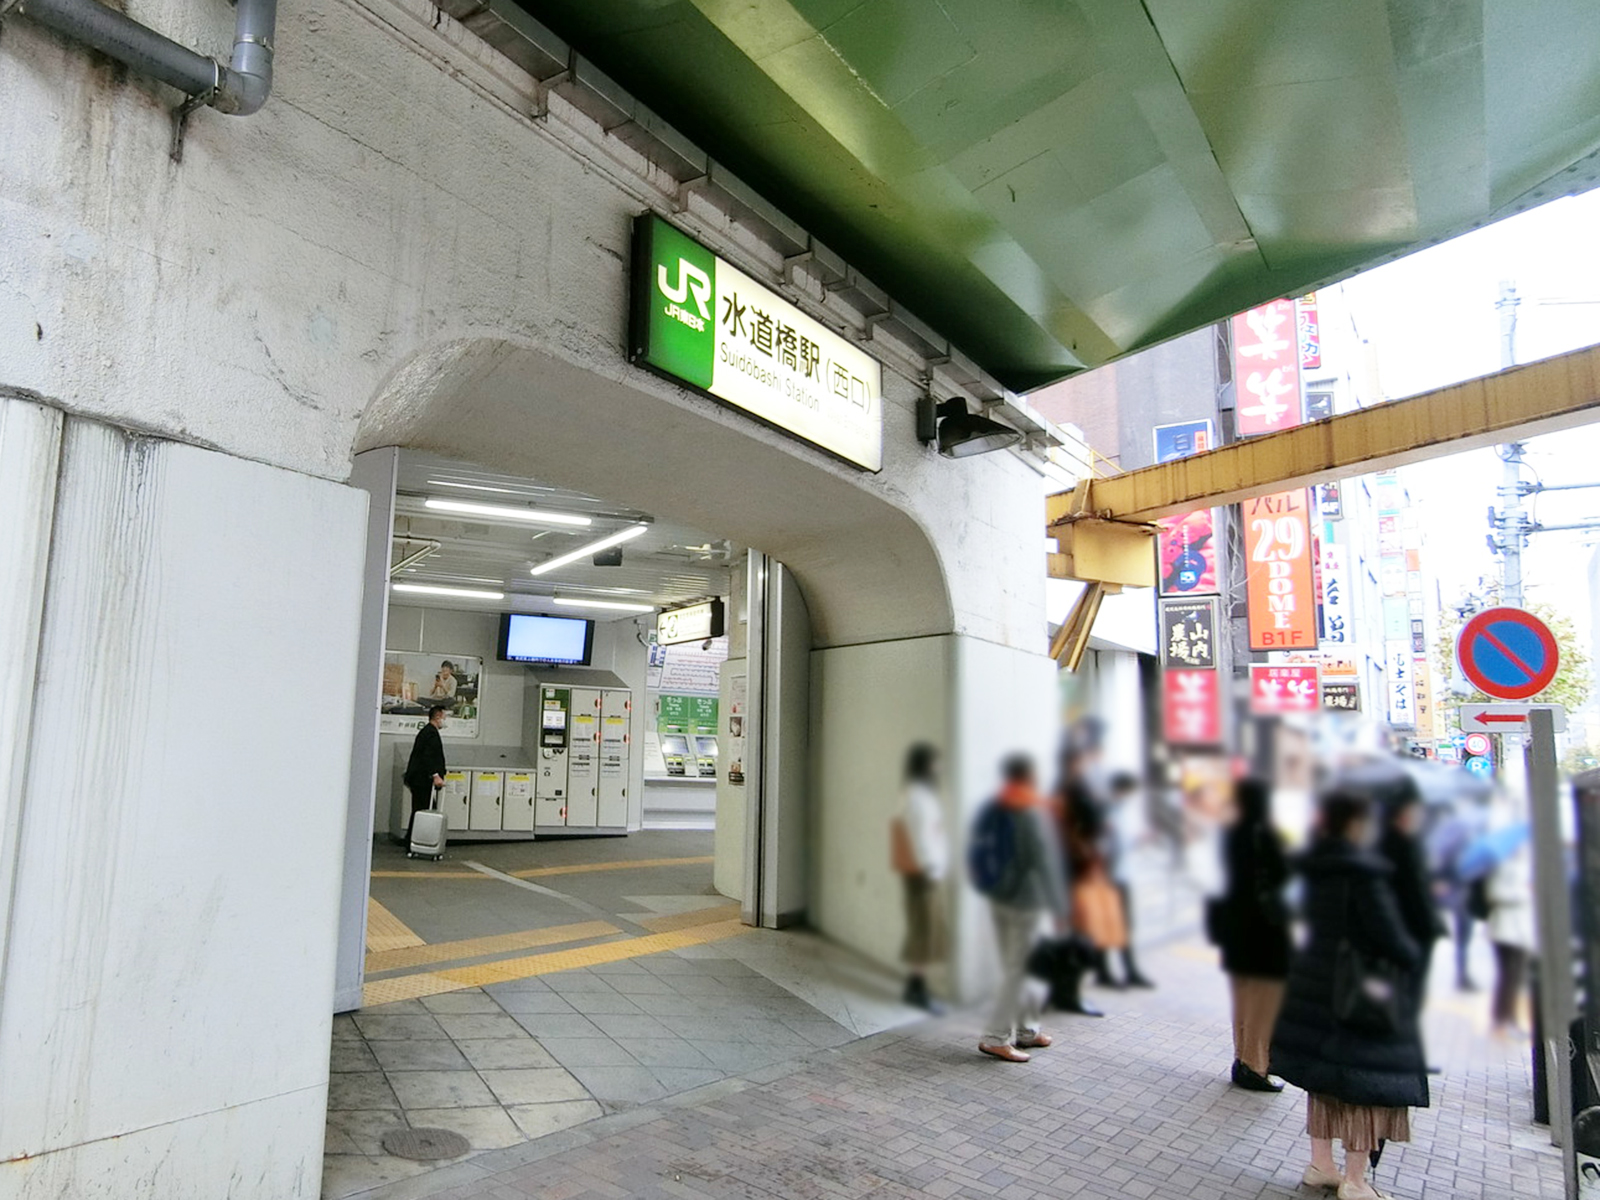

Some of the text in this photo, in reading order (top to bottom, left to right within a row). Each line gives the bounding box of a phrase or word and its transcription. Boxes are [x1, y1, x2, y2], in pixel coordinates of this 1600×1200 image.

[658, 257, 711, 321] JR
[719, 341, 820, 413] Suidōbashi Station
[1251, 493, 1300, 515] バル
[1251, 515, 1306, 563] 29
[1267, 560, 1296, 630] DOME
[1261, 630, 1303, 646] B1F
